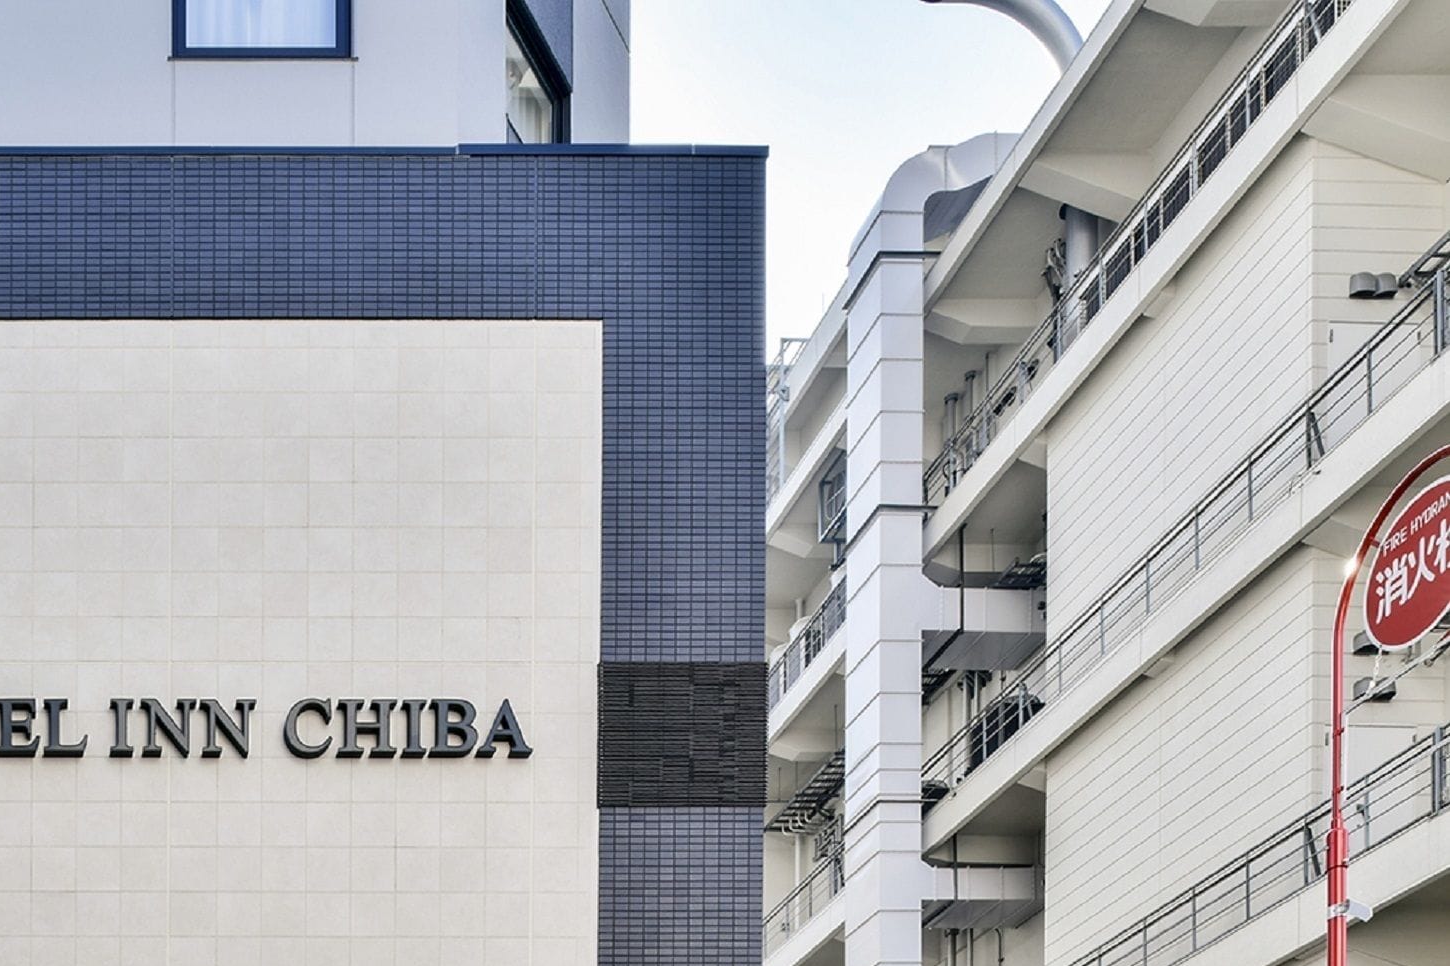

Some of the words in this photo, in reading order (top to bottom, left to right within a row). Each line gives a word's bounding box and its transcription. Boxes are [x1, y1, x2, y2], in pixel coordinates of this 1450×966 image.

[1383, 526, 1407, 557] FIRE
[109, 697, 256, 758] INN
[283, 697, 533, 758] CHIBA
